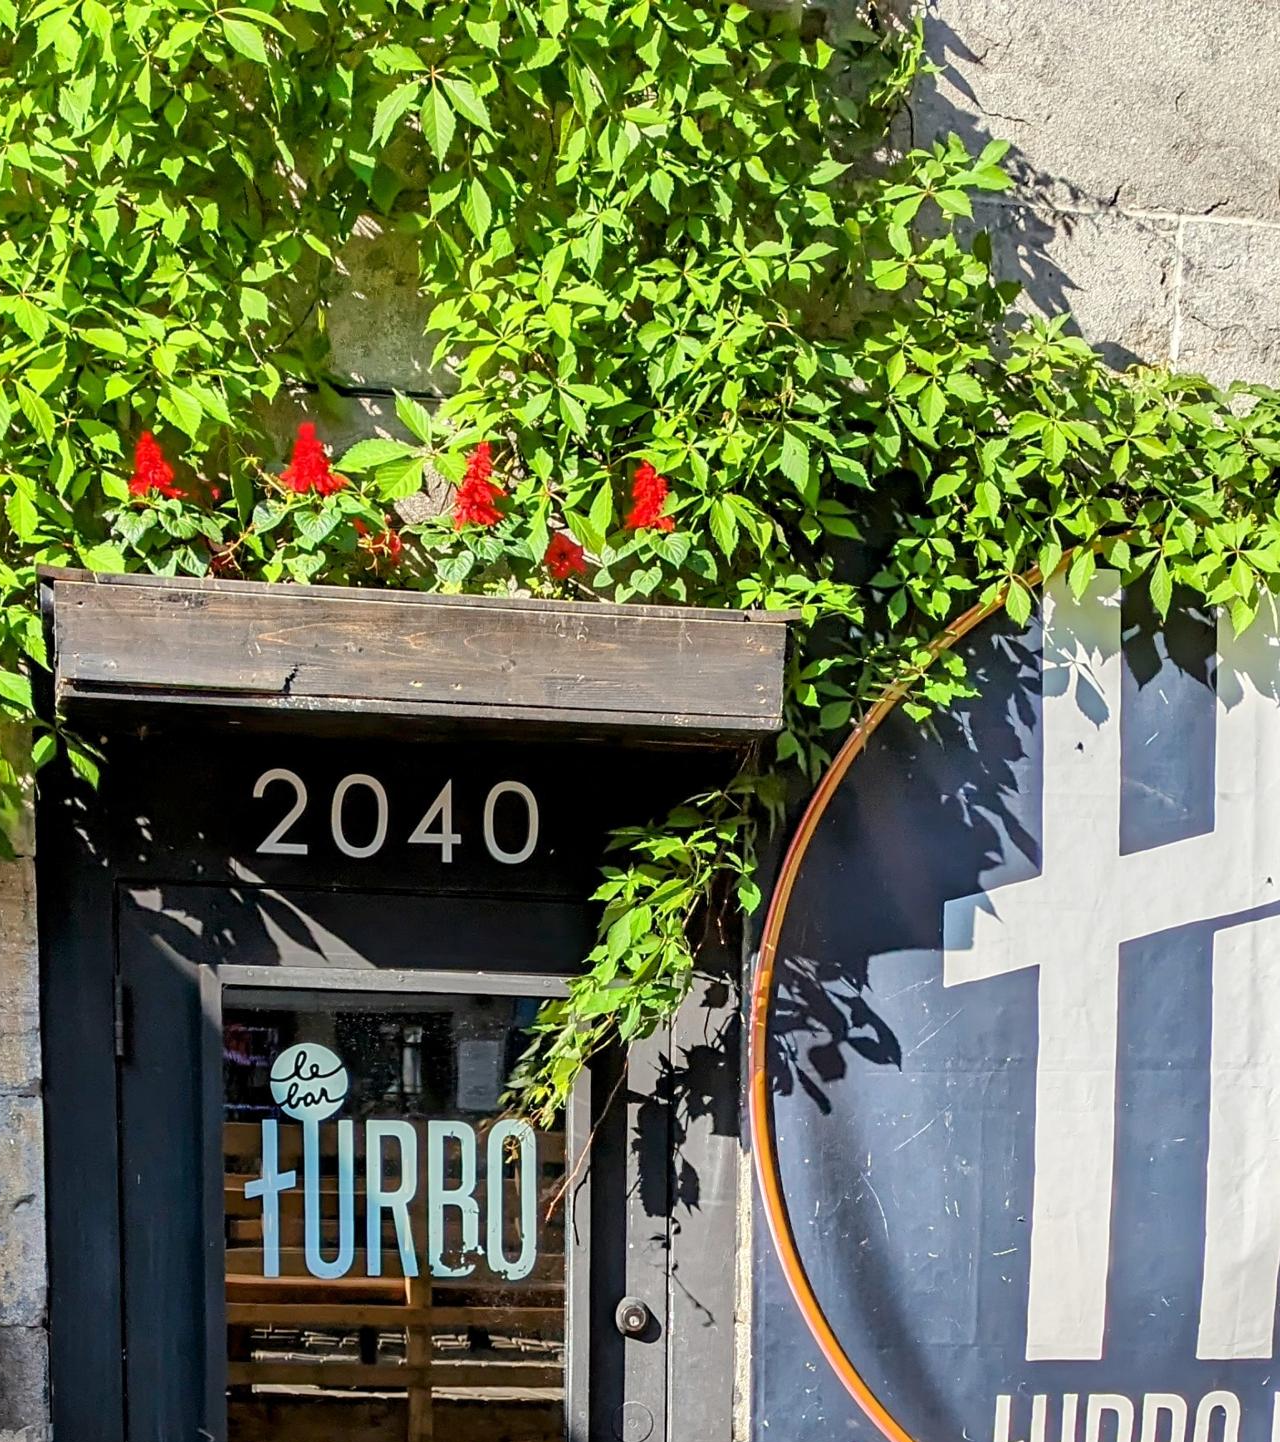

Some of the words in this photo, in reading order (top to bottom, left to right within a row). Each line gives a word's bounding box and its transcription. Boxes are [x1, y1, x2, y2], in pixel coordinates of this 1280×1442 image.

[252, 768, 540, 865] 2040
[271, 1050, 344, 1083] le
[278, 1083, 345, 1110] bar
